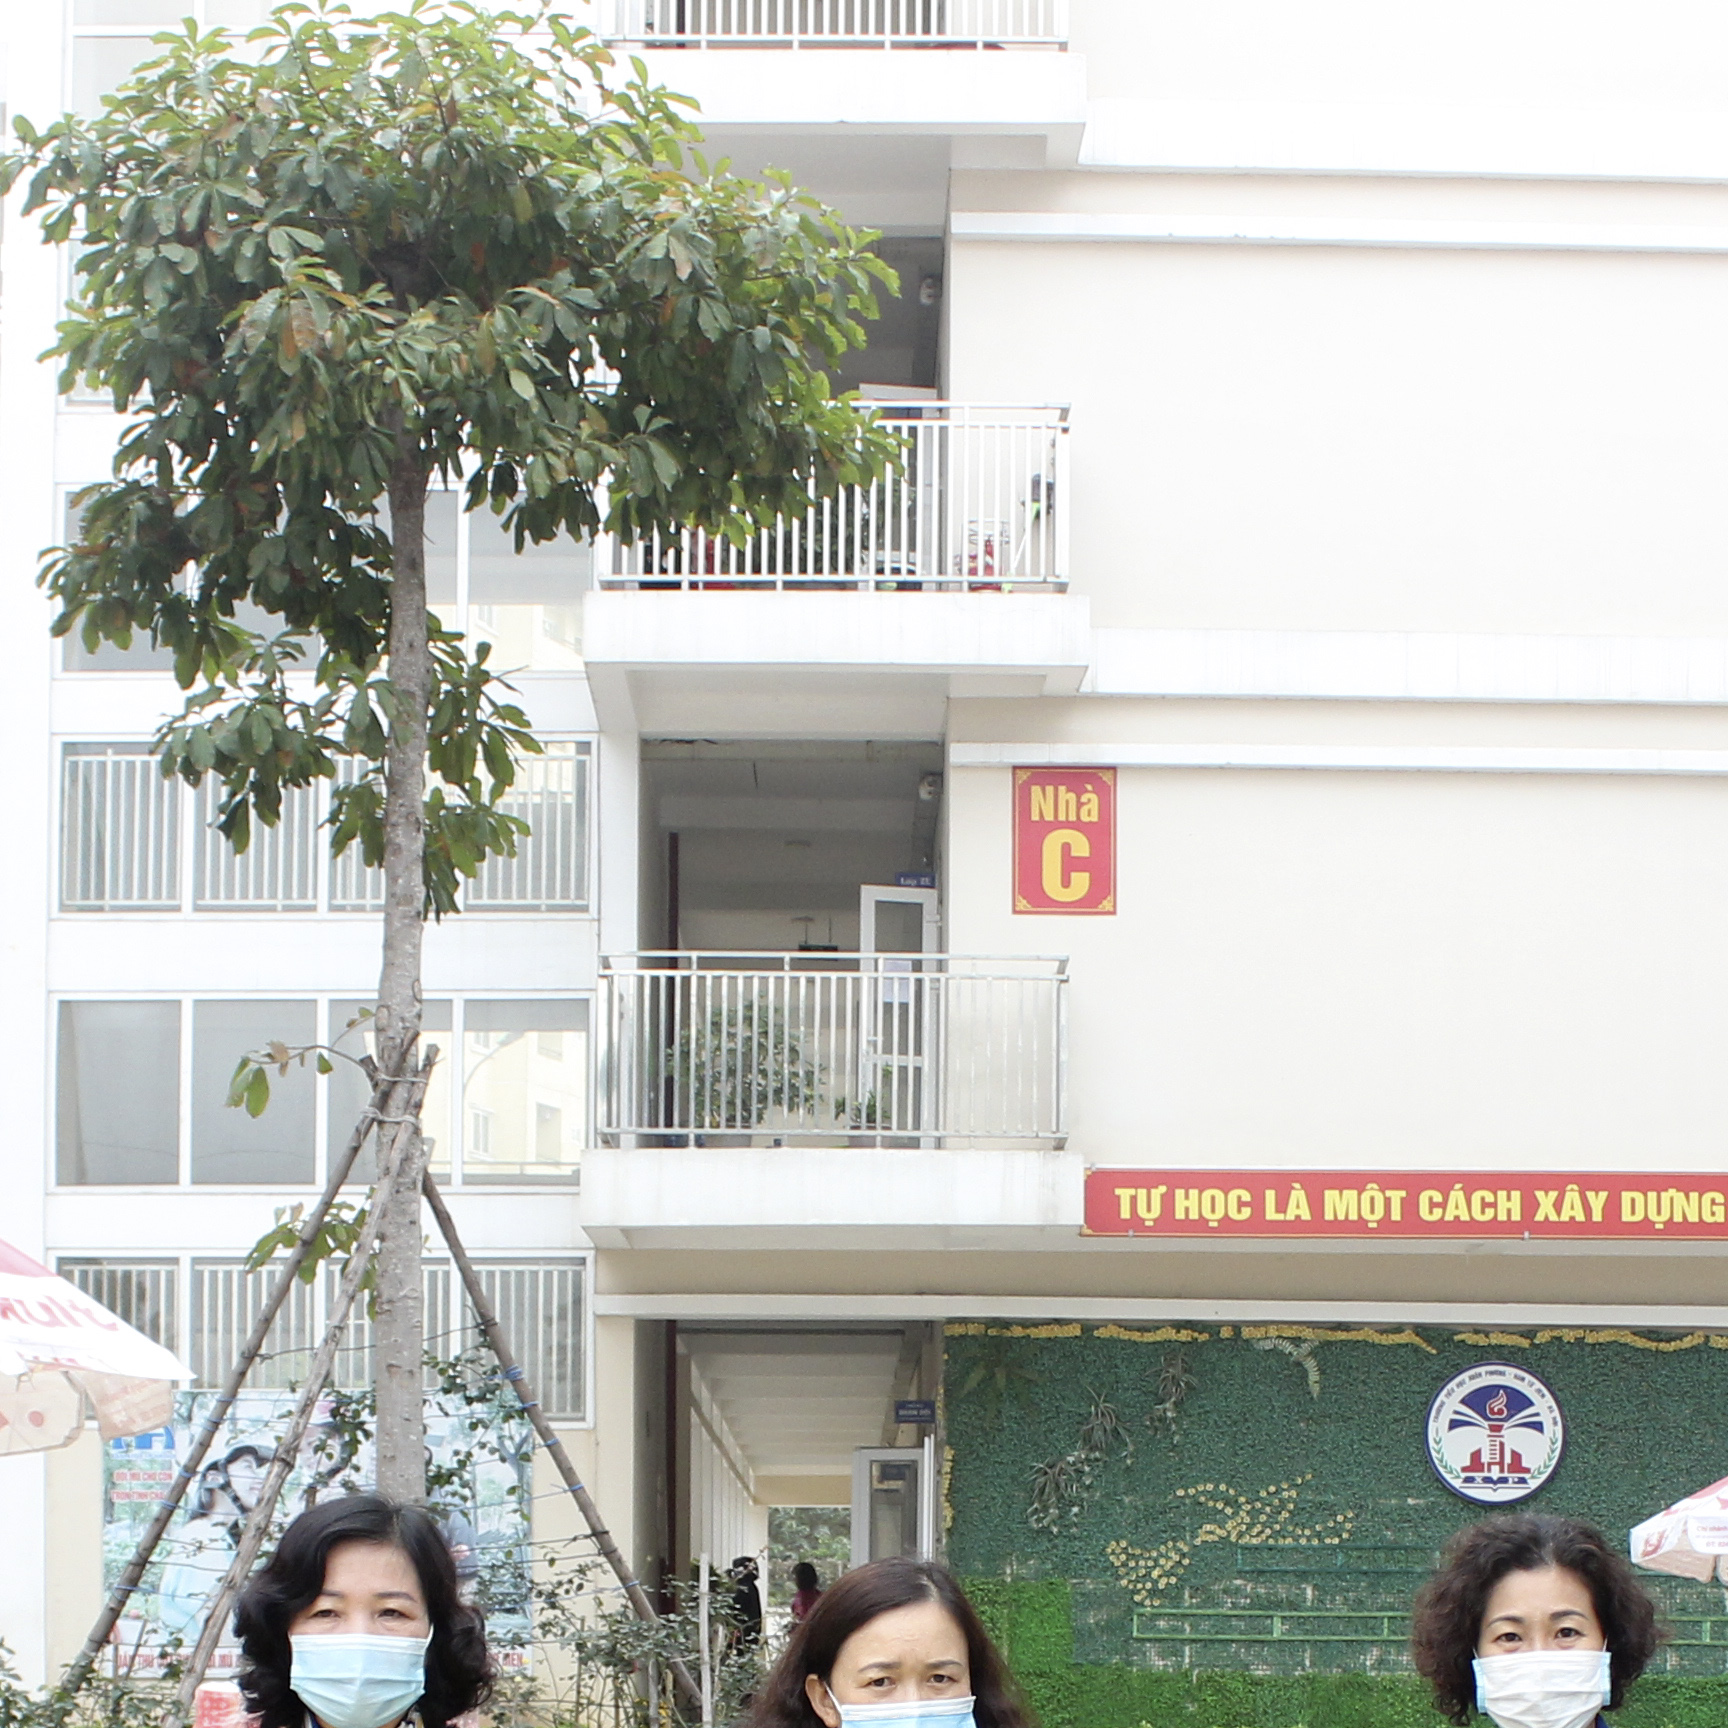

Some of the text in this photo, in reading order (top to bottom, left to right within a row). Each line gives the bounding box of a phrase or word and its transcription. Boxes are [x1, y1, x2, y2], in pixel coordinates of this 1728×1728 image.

[1031, 784, 1099, 822] Nhà
[1042, 828, 1090, 902] C
[1115, 1185, 1167, 1226] TỰ
[1174, 1188, 1252, 1227] HỌC
[1265, 1183, 1312, 1222] LÀ
[1323, 1183, 1406, 1228] MỘT
[1418, 1183, 1521, 1222] CÁCH
[1533, 1184, 1608, 1223] XÂY
[1621, 1188, 1726, 1229] DỰNG
